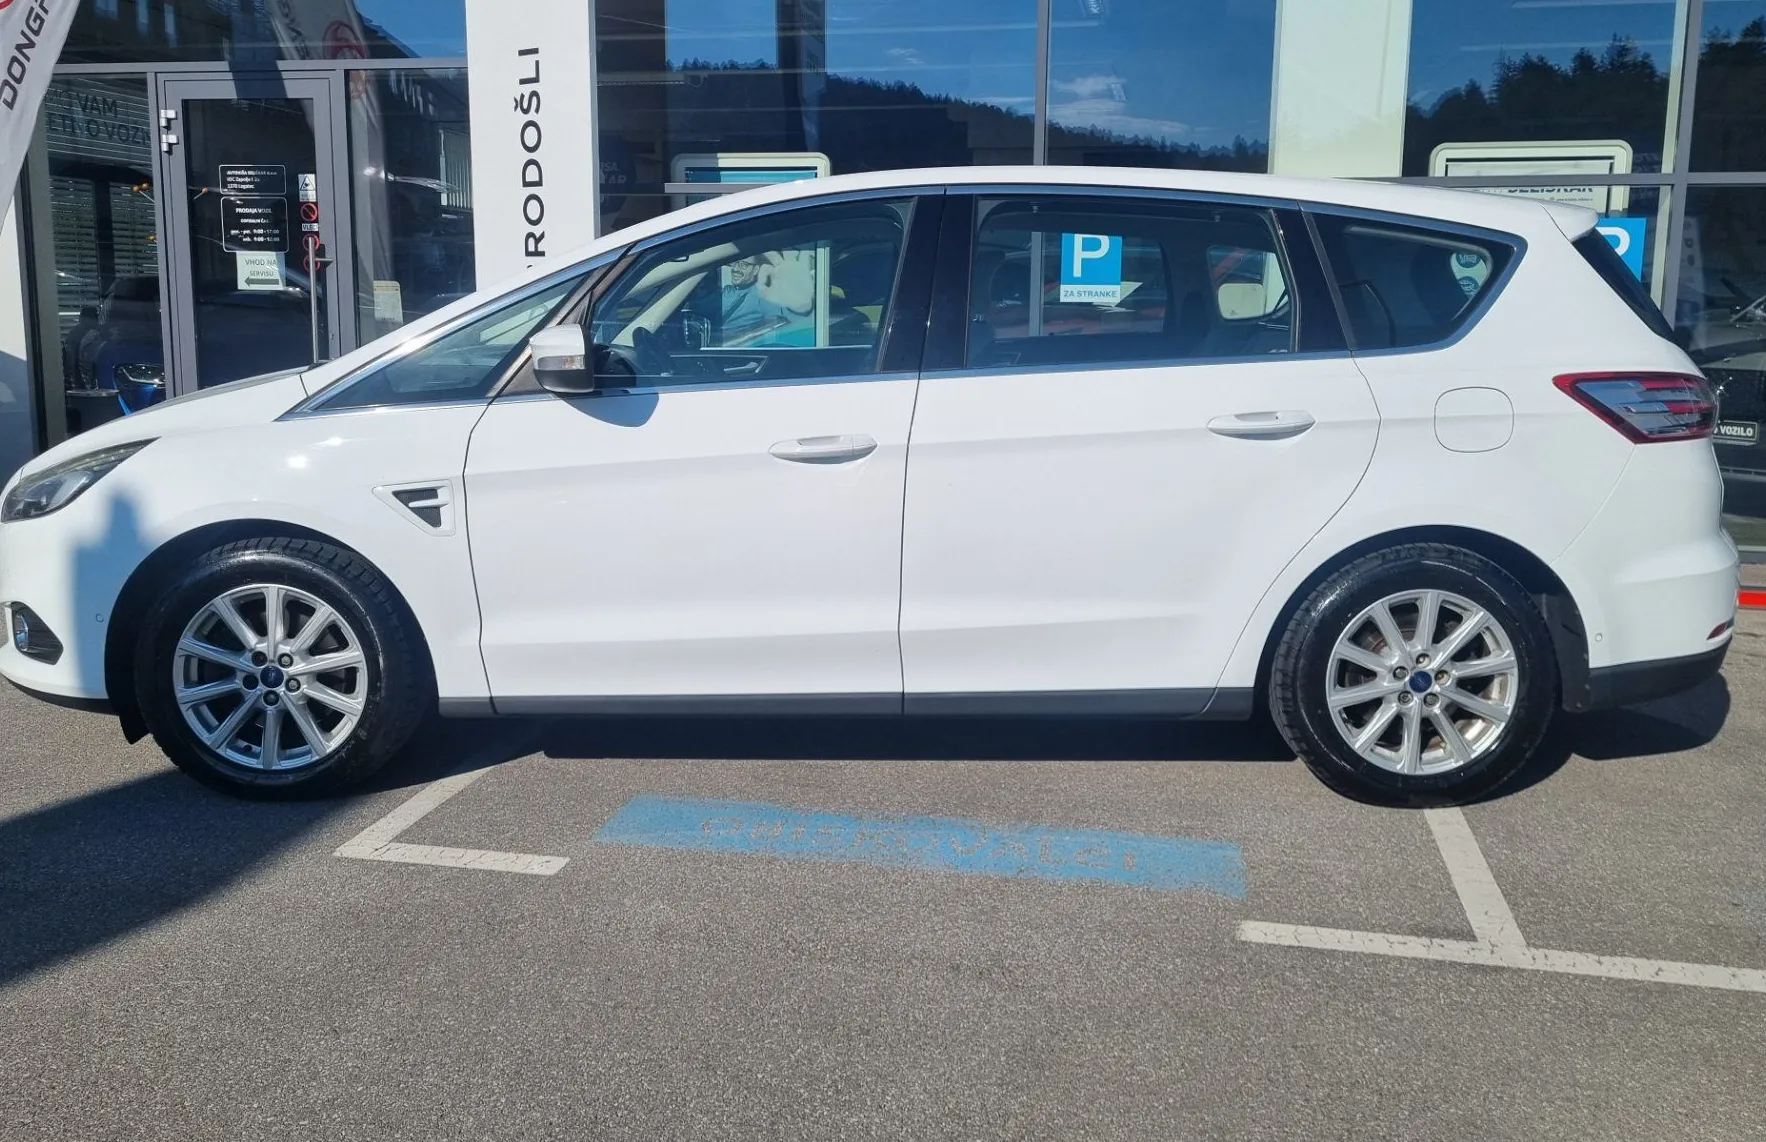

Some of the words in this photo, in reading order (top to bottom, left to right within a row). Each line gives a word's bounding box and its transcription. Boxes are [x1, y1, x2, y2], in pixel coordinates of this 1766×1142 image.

[513, 47, 546, 269] RODOŠLI
[1072, 234, 1110, 279] P
[1063, 290, 1075, 298] ZA
[1076, 290, 1118, 298] STRANKE
[1720, 425, 1754, 437] VOZILO
